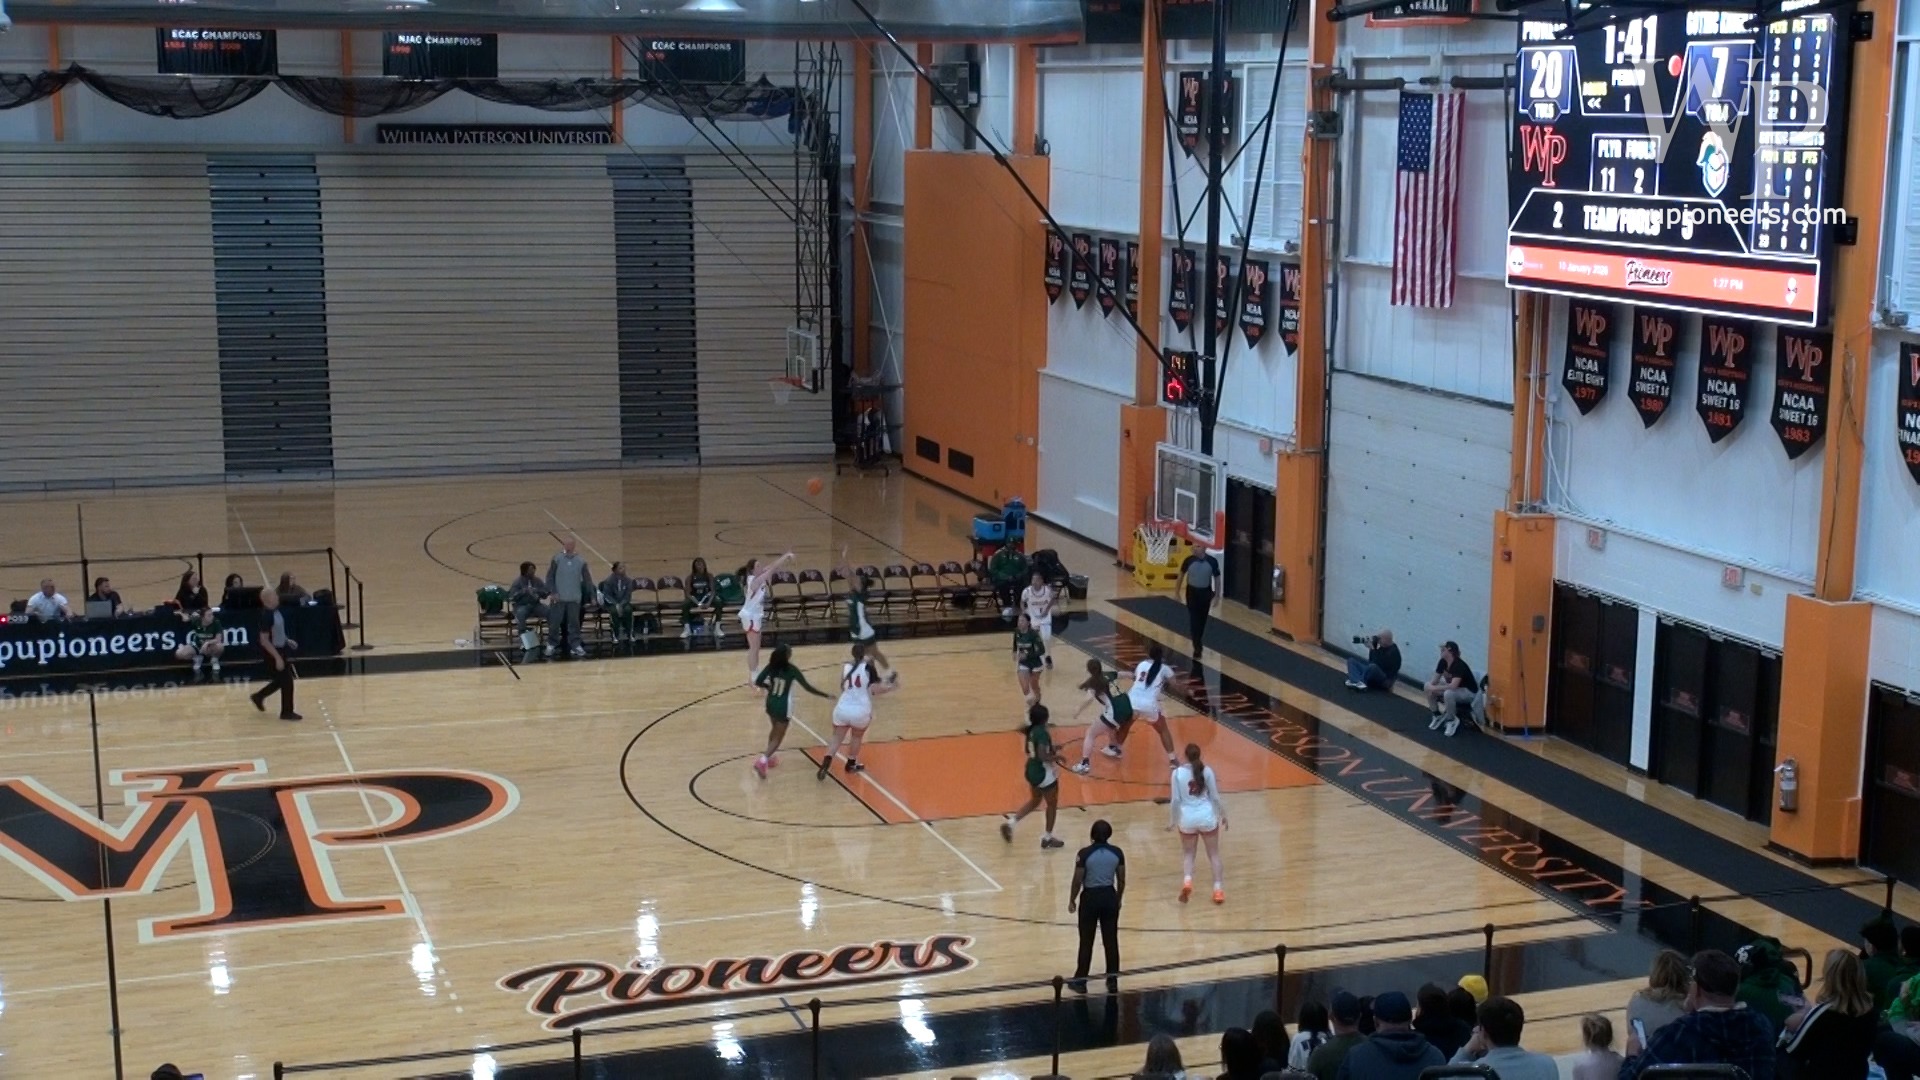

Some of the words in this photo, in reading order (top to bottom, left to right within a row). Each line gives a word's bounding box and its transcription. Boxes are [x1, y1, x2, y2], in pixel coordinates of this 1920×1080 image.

[202, 31, 262, 40] CHAMPIONS
[425, 36, 482, 46] CHAMPIONS
[1602, 15, 1658, 64] 1:41
[678, 42, 732, 51] CHAMPIONS
[1529, 51, 1563, 98] 20
[1711, 47, 1729, 98] 7
[1624, 93, 1632, 112] 1
[382, 129, 449, 144] WILLIAM
[454, 129, 527, 144] PATERSON
[530, 129, 614, 144] UNIVERSITY
[1519, 125, 1568, 187] WP
[1625, 139, 1657, 160] FOULS
[1600, 167, 1616, 192] 11
[1634, 167, 1645, 194] 2
[1552, 201, 1564, 228] 2
[1575, 307, 1606, 346] WP
[1641, 315, 1673, 356] WP
[1708, 325, 1746, 368] WP
[1575, 356, 1599, 373] NCAA
[1785, 335, 1823, 382] WP
[1640, 367, 1668, 384] NCAA
[1635, 381, 1659, 395] SWEET
[1707, 379, 1737, 396] NCAA
[1702, 393, 1727, 409] SWEET
[1782, 392, 1816, 412] NCAA
[1779, 408, 1805, 426] SWEET
[1807, 413, 1819, 427] 16
[773, 677, 786, 697] 11
[496, 934, 977, 1030] Pioneers
